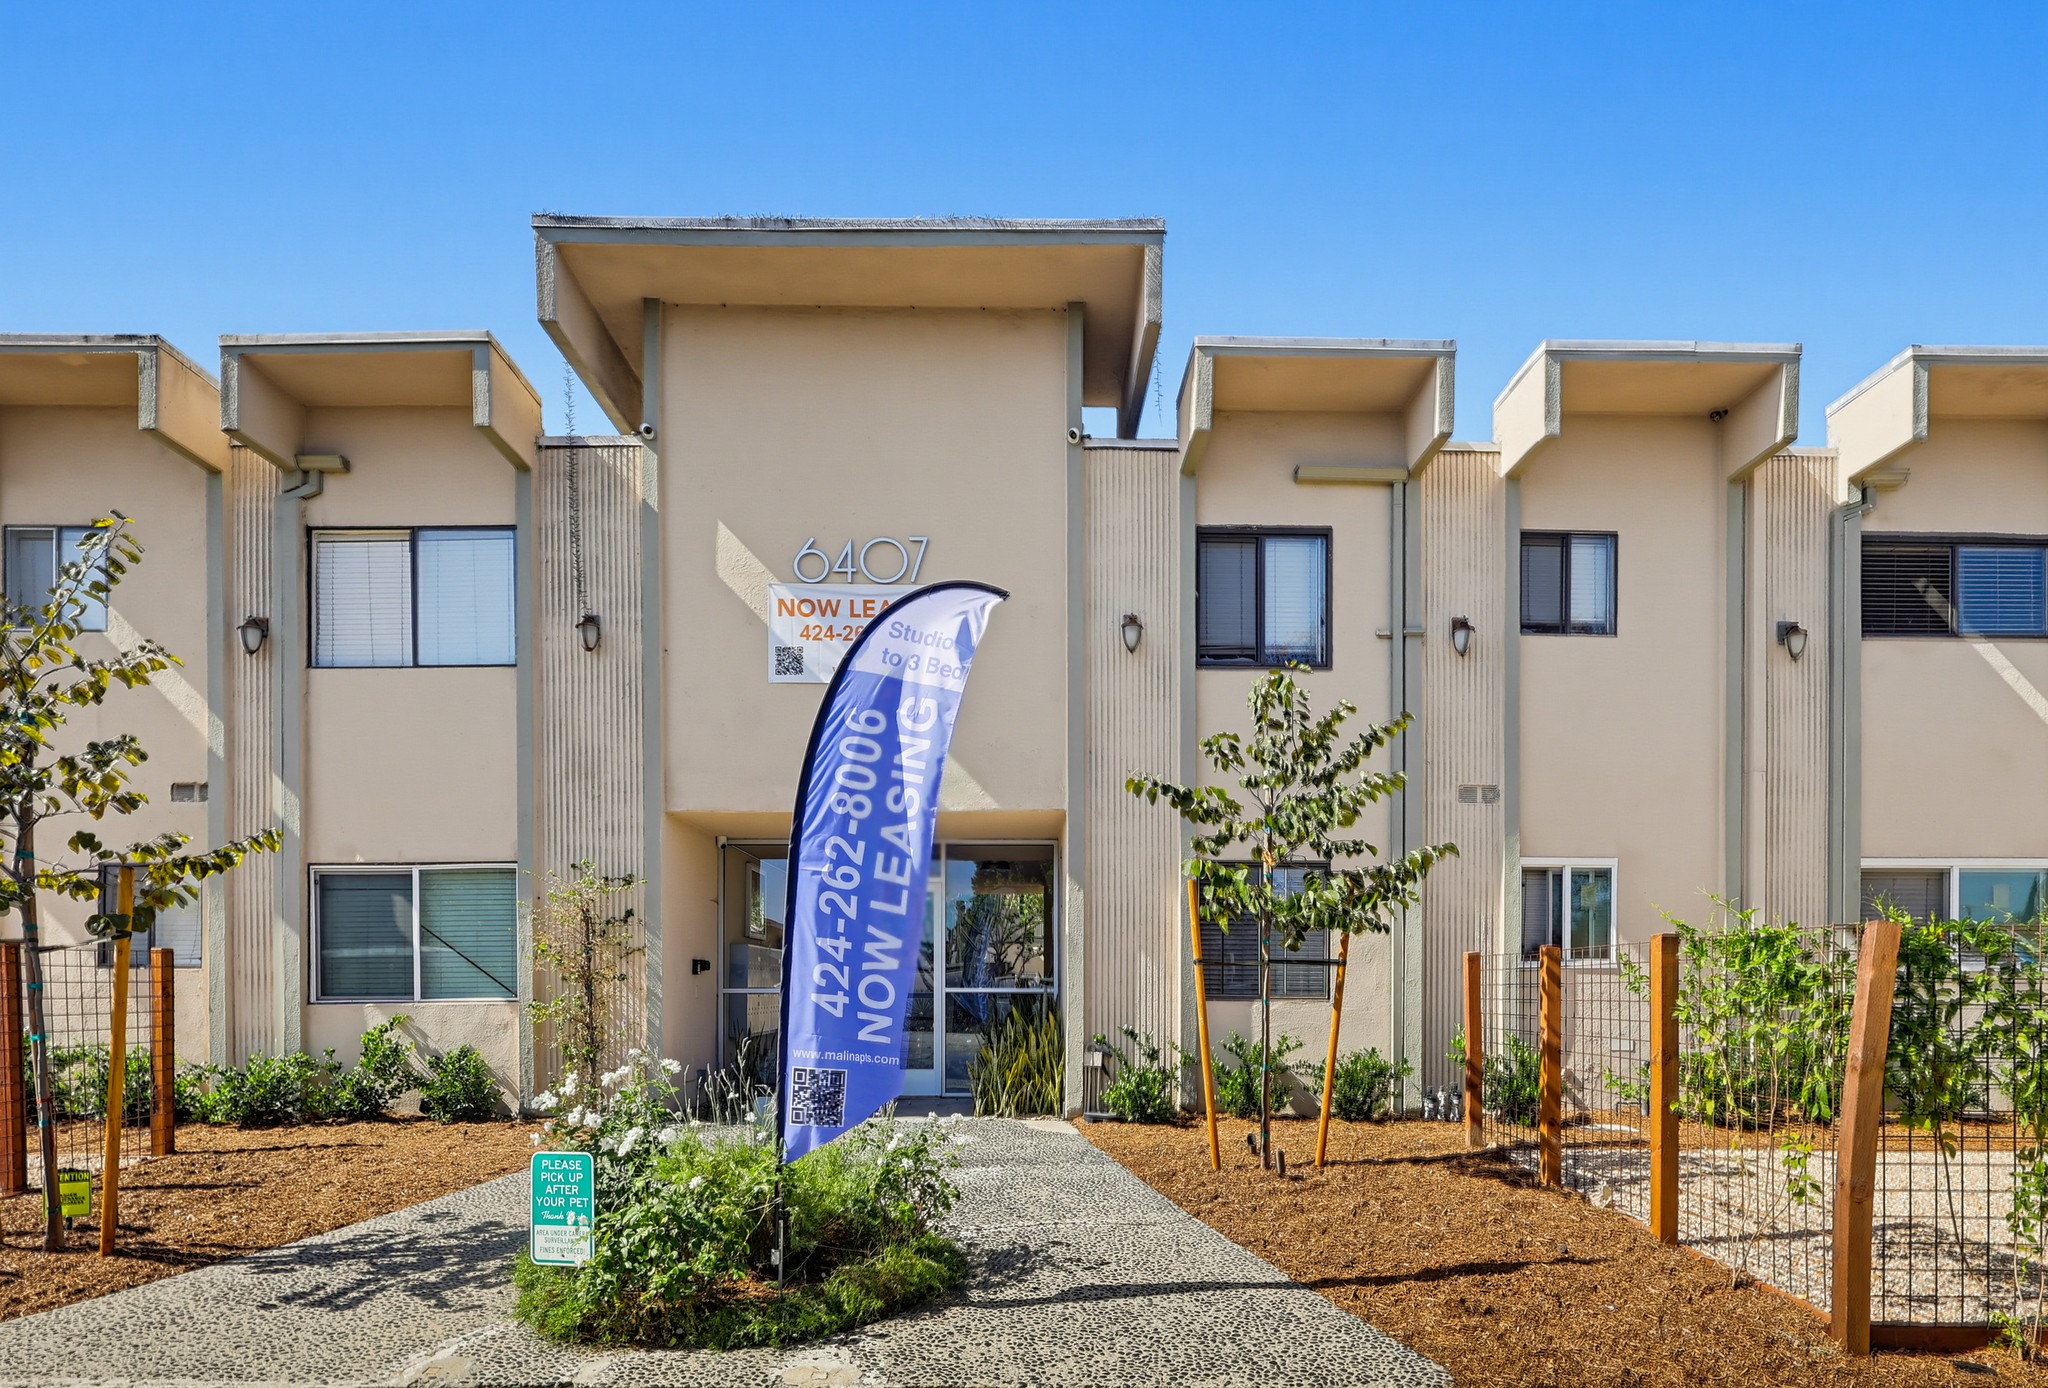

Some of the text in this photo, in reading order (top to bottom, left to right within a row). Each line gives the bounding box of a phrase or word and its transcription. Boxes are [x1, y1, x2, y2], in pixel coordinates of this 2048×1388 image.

[793, 536, 929, 584] 6407
[777, 598, 841, 618] NOW
[888, 620, 955, 650] Studio
[881, 647, 902, 667] to
[908, 653, 920, 671] 3
[810, 709, 887, 1018] 424-262-8006
[856, 695, 938, 1045] NOW LEASING
[793, 1048, 900, 1065] www.malinapts.com
[541, 1160, 582, 1170] PLEASE
[541, 1172, 583, 1182] PICK UP
[545, 1184, 579, 1195] AFTER
[535, 1196, 589, 1208] YOUR PET
[541, 1210, 564, 1220] Thank
